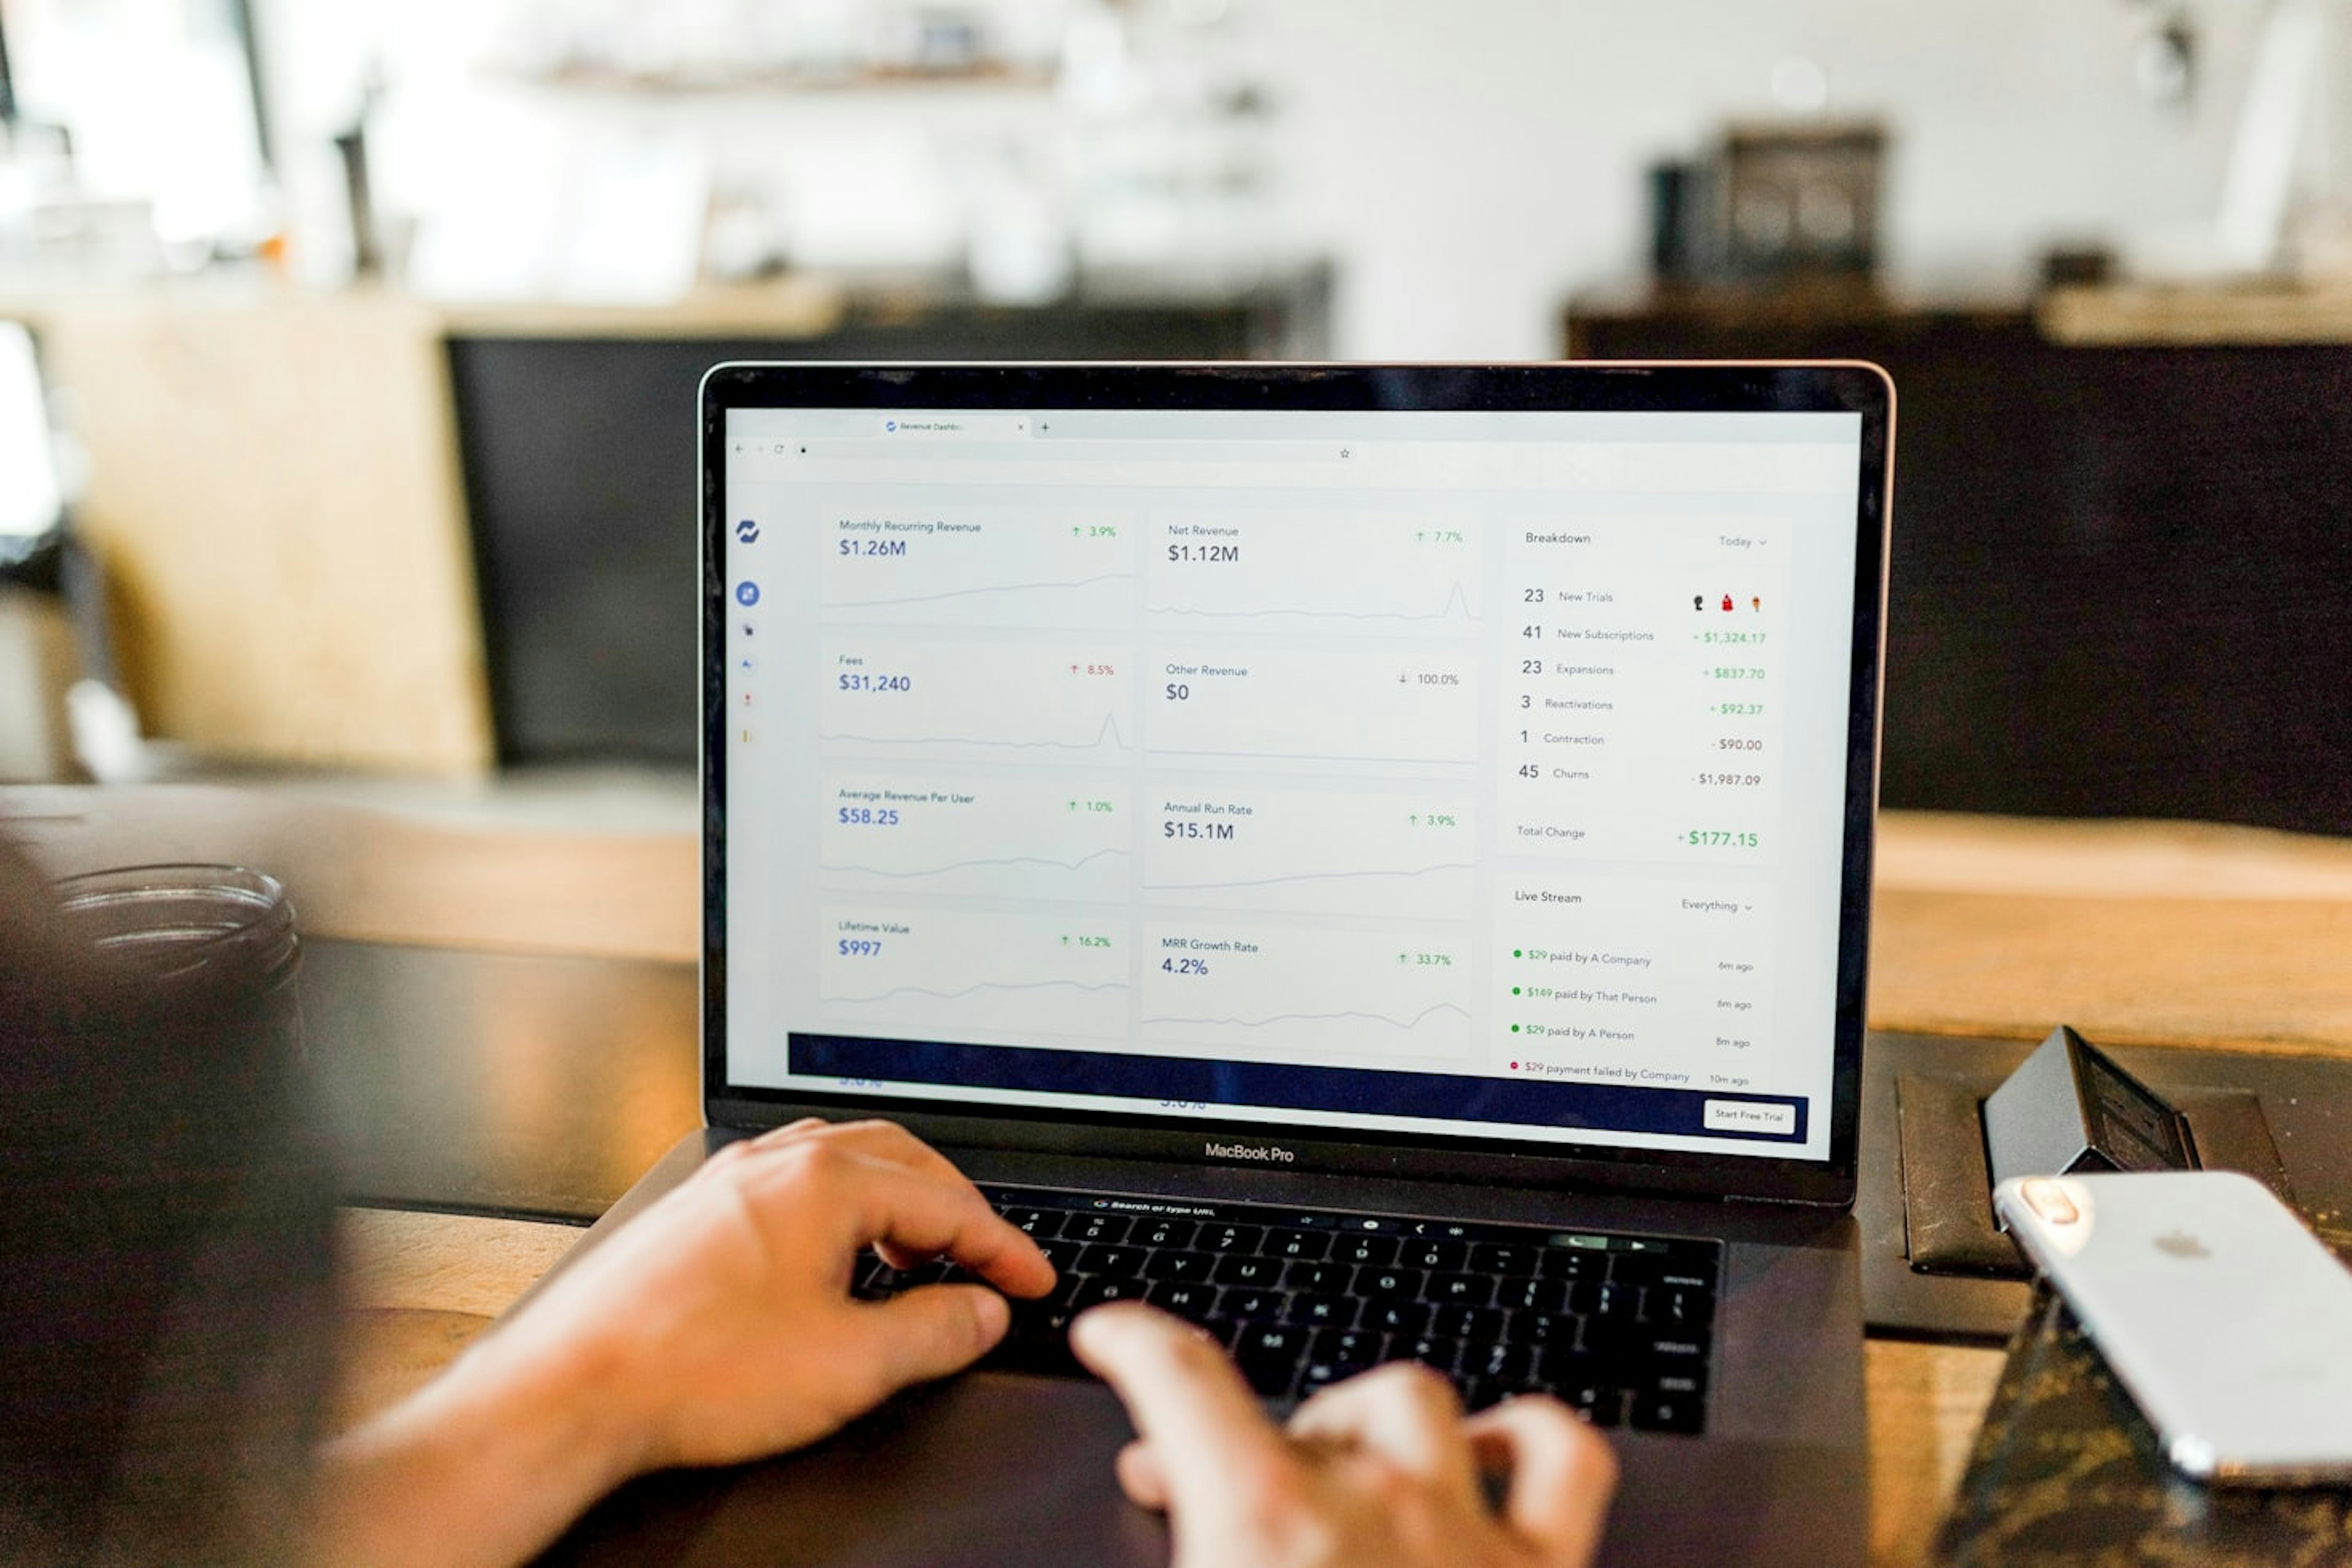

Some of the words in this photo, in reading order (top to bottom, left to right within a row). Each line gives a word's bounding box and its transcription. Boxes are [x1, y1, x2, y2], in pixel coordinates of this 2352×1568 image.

[840, 520, 882, 533] Monthly
[884, 521, 934, 534] Recurring
[937, 521, 981, 532] Revenue
[1090, 526, 1116, 537] 3.9%
[1169, 525, 1189, 535] Net
[1192, 525, 1238, 536] Revenue
[1435, 531, 1463, 543] 7.7%
[1526, 532, 1591, 543] Breakdown
[1720, 536, 1751, 548] Today
[840, 539, 906, 556] $1.26M
[1169, 545, 1238, 562] $1.12M
[1525, 589, 1544, 602] 23
[1559, 592, 1583, 601] New
[1586, 592, 1613, 602] Trials
[1523, 625, 1540, 639] 41
[1558, 629, 1581, 638] New
[1585, 629, 1654, 643] Subscriptions
[1704, 631, 1766, 644] $1,324.17
[839, 655, 863, 665] Fees
[1088, 665, 1114, 675] 8.5%
[1166, 664, 1198, 674] Other
[1201, 665, 1248, 676] Revenue
[1523, 660, 1542, 674] 23
[1556, 664, 1614, 676] Expansions
[1715, 667, 1765, 679] $837.70
[840, 674, 910, 692] $31,240
[1418, 674, 1459, 685] 100.0%
[1166, 684, 1189, 700] $0
[1521, 695, 1530, 709] 3
[1545, 699, 1613, 710] Reactivations
[1721, 704, 1764, 715] $92.37
[1521, 730, 1527, 742] 1
[1544, 733, 1604, 745] Contraction
[1719, 739, 1762, 750] $90.00
[1519, 764, 1538, 778] 45
[1553, 768, 1589, 779] Churns
[1699, 773, 1761, 786] $1,987.09
[839, 789, 881, 802] Average
[884, 790, 928, 802] Revenue
[931, 792, 948, 802] Per
[951, 794, 974, 804] User
[1087, 801, 1112, 812] 1.0%
[1164, 802, 1201, 813] Annual
[1204, 803, 1224, 814] Run
[1228, 804, 1253, 815] Rate
[839, 807, 899, 825] $58.25
[1428, 815, 1455, 826] 3.9%
[1164, 821, 1234, 840] $15.1M
[1518, 826, 1543, 836] Total
[1545, 827, 1585, 840] Change
[1689, 830, 1758, 847] $177.15
[1515, 891, 1538, 901] Live
[1541, 891, 1581, 903] Stream
[1682, 899, 1738, 913] Everything
[839, 921, 880, 932] Lifetime
[882, 924, 910, 934] Value
[839, 939, 881, 956] $997
[1079, 936, 1110, 948] 16.2%
[1163, 938, 1187, 948] MRR
[1190, 939, 1231, 951] Growth
[1234, 941, 1258, 952] Rate
[1417, 954, 1452, 966] 33.7%
[1528, 950, 1547, 960] $29
[1550, 952, 1572, 963] paid
[1575, 952, 1588, 965] by
[1591, 954, 1599, 962] A
[1602, 954, 1651, 968] Company
[1162, 958, 1208, 974] 4.2%
[1736, 964, 1754, 973] ago
[1527, 987, 1553, 997] $149
[1555, 990, 1578, 1001] paid
[1580, 990, 1593, 1003] by
[1596, 992, 1618, 1002] That
[1622, 993, 1657, 1005] Person
[1735, 1003, 1752, 1011] ago
[1526, 1025, 1545, 1035] $29
[1548, 1027, 1570, 1037] paid
[1572, 1028, 1586, 1040] by
[1600, 1029, 1634, 1040] Person
[1733, 1040, 1751, 1049] ago
[1525, 1062, 1544, 1071] $29
[1547, 1066, 1591, 1076] payment
[1594, 1066, 1622, 1077] failed
[1625, 1068, 1638, 1080] by
[1640, 1069, 1690, 1084] Company
[1710, 1075, 1728, 1084] 10m
[1716, 1109, 1737, 1118] Start
[1741, 1111, 1761, 1120] Free
[1764, 1112, 1784, 1121] Trial
[1205, 1144, 1269, 1159] MacBook
[1271, 1147, 1294, 1162] Pro
[1111, 1200, 1150, 1211] Search
[1241, 1265, 1256, 1277] U
